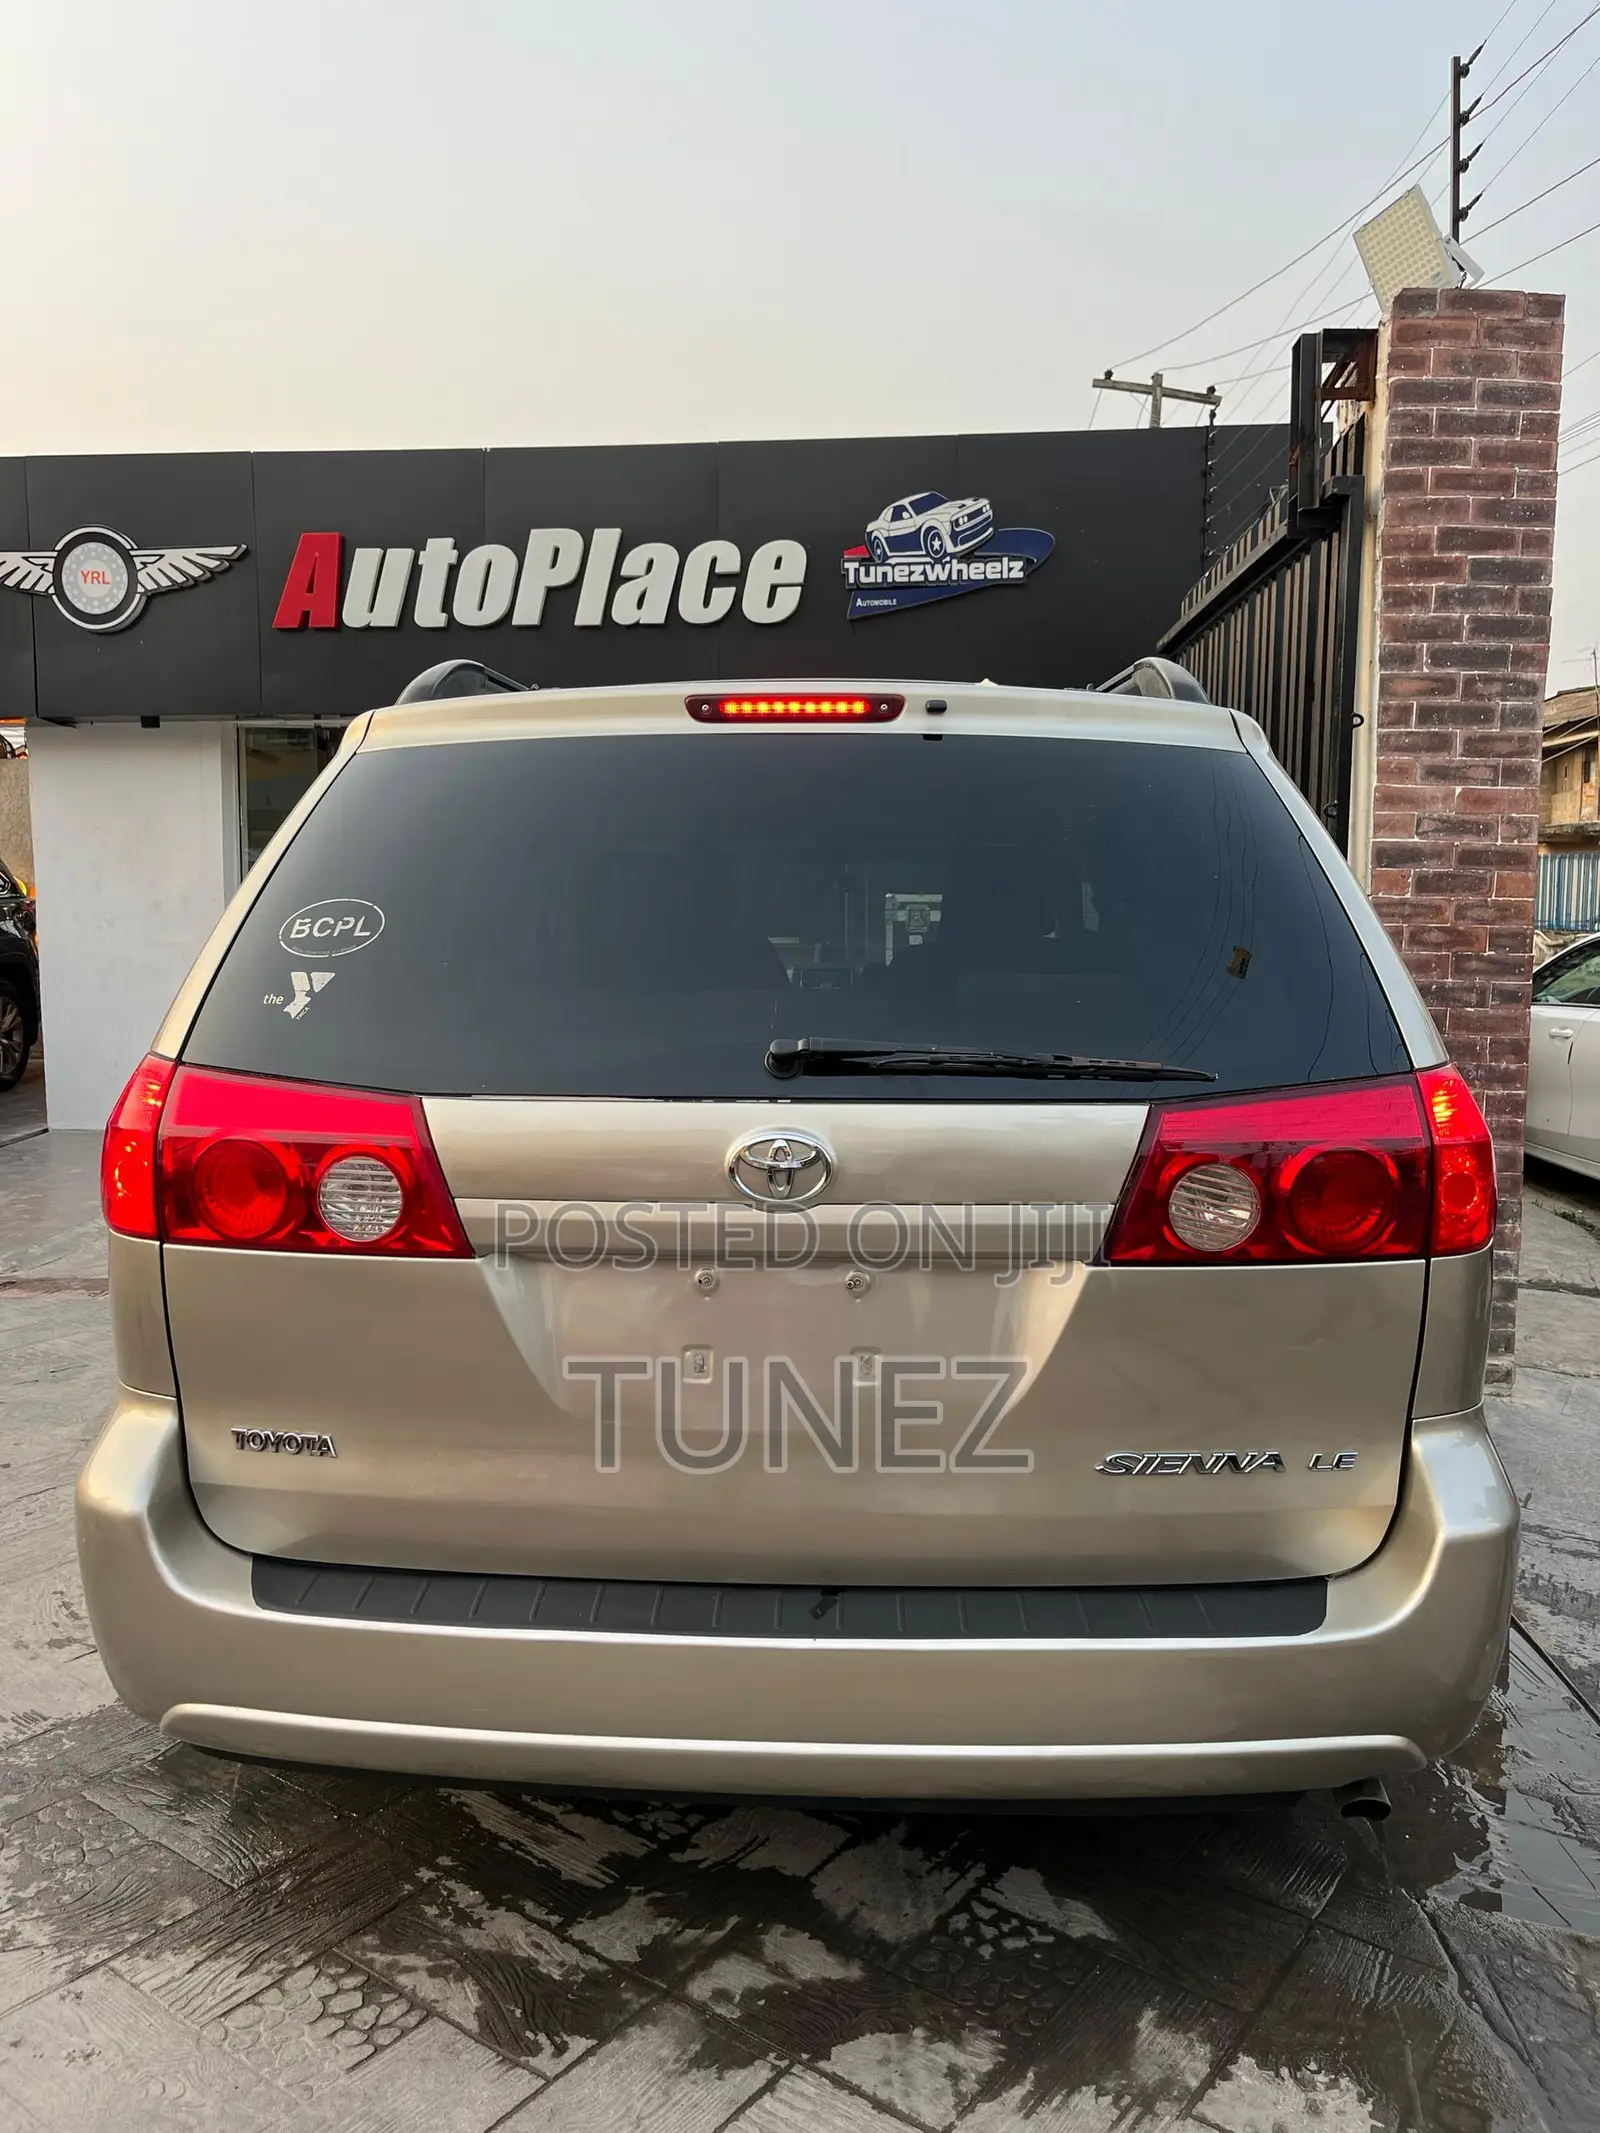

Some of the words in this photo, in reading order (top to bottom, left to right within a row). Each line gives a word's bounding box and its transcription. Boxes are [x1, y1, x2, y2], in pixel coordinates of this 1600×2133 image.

[80, 569, 111, 585] YRL
[272, 527, 809, 630] AutoPlace
[843, 556, 1024, 584] Tunezwheelz
[289, 916, 372, 939] BCPL
[263, 993, 284, 1005] the
[230, 1427, 337, 1458] TOYOTA
[1094, 1450, 1287, 1476] SIENNA
[1308, 1451, 1359, 1472] LE
